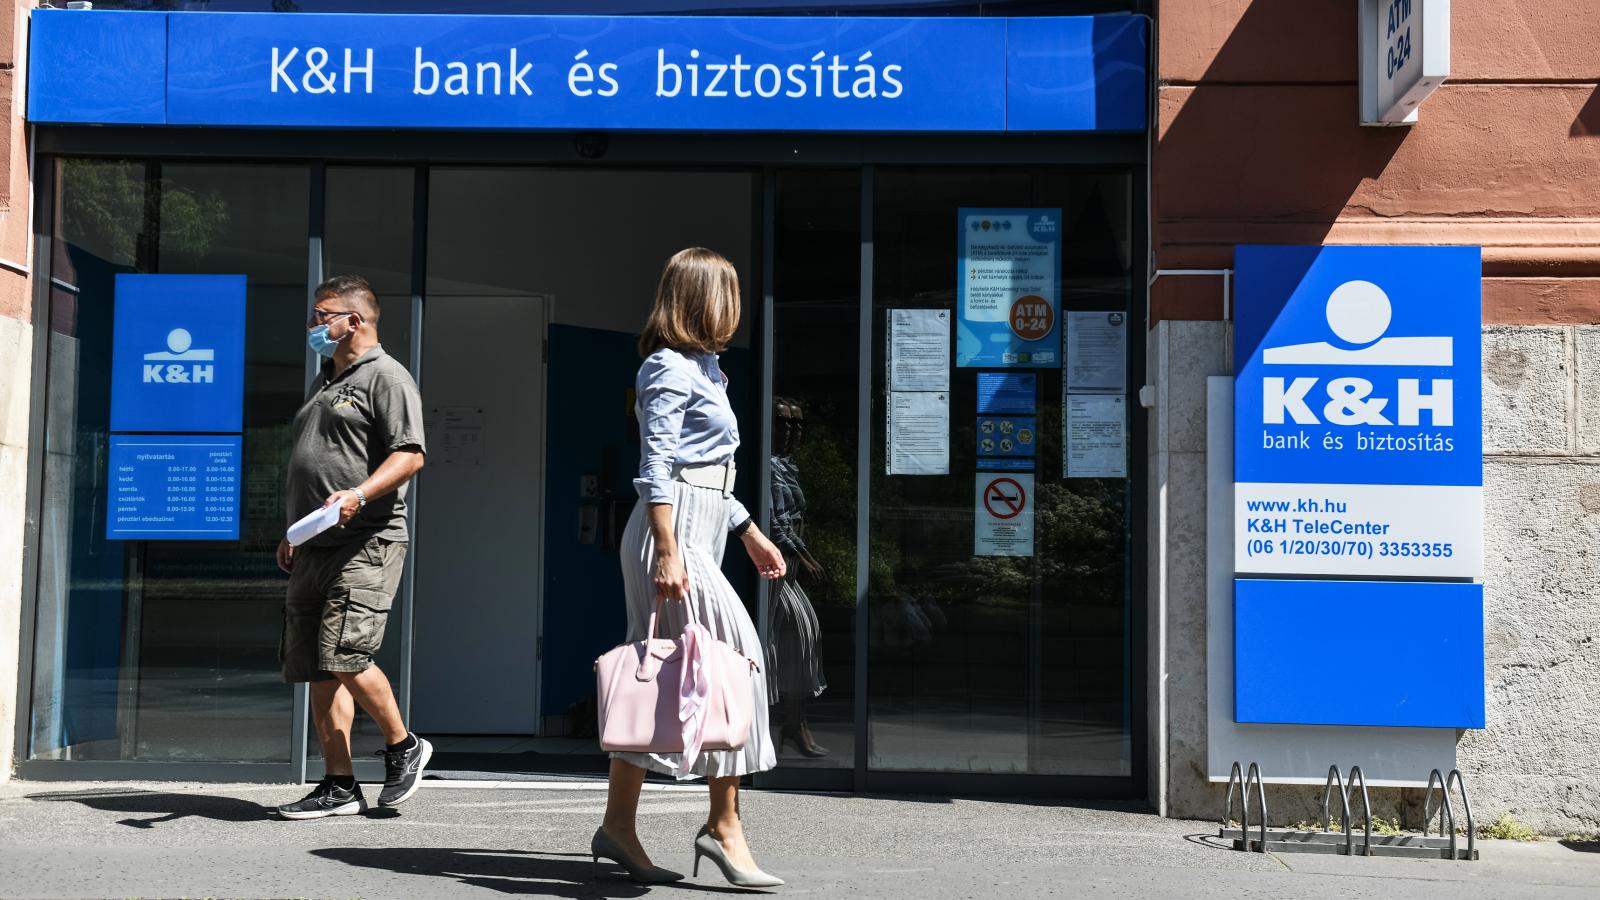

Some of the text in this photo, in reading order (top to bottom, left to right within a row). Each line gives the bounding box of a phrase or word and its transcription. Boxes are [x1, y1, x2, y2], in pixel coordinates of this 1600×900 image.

[1387, 26, 1411, 80] 0-24
[271, 46, 903, 98] K&H bank és biztosítás
[1016, 304, 1047, 317] ATM
[1015, 318, 1047, 331] 0-24
[143, 364, 214, 384] K&H
[1263, 376, 1454, 427] K&H
[1263, 430, 1454, 452] bank és biztosítás
[136, 453, 175, 462] nyitvatartás
[1246, 498, 1347, 514] www.kh.hu
[1247, 518, 1390, 535] K&H TeleCenter
[1247, 539, 1453, 560] (06 1/20/30/70) 3353355
